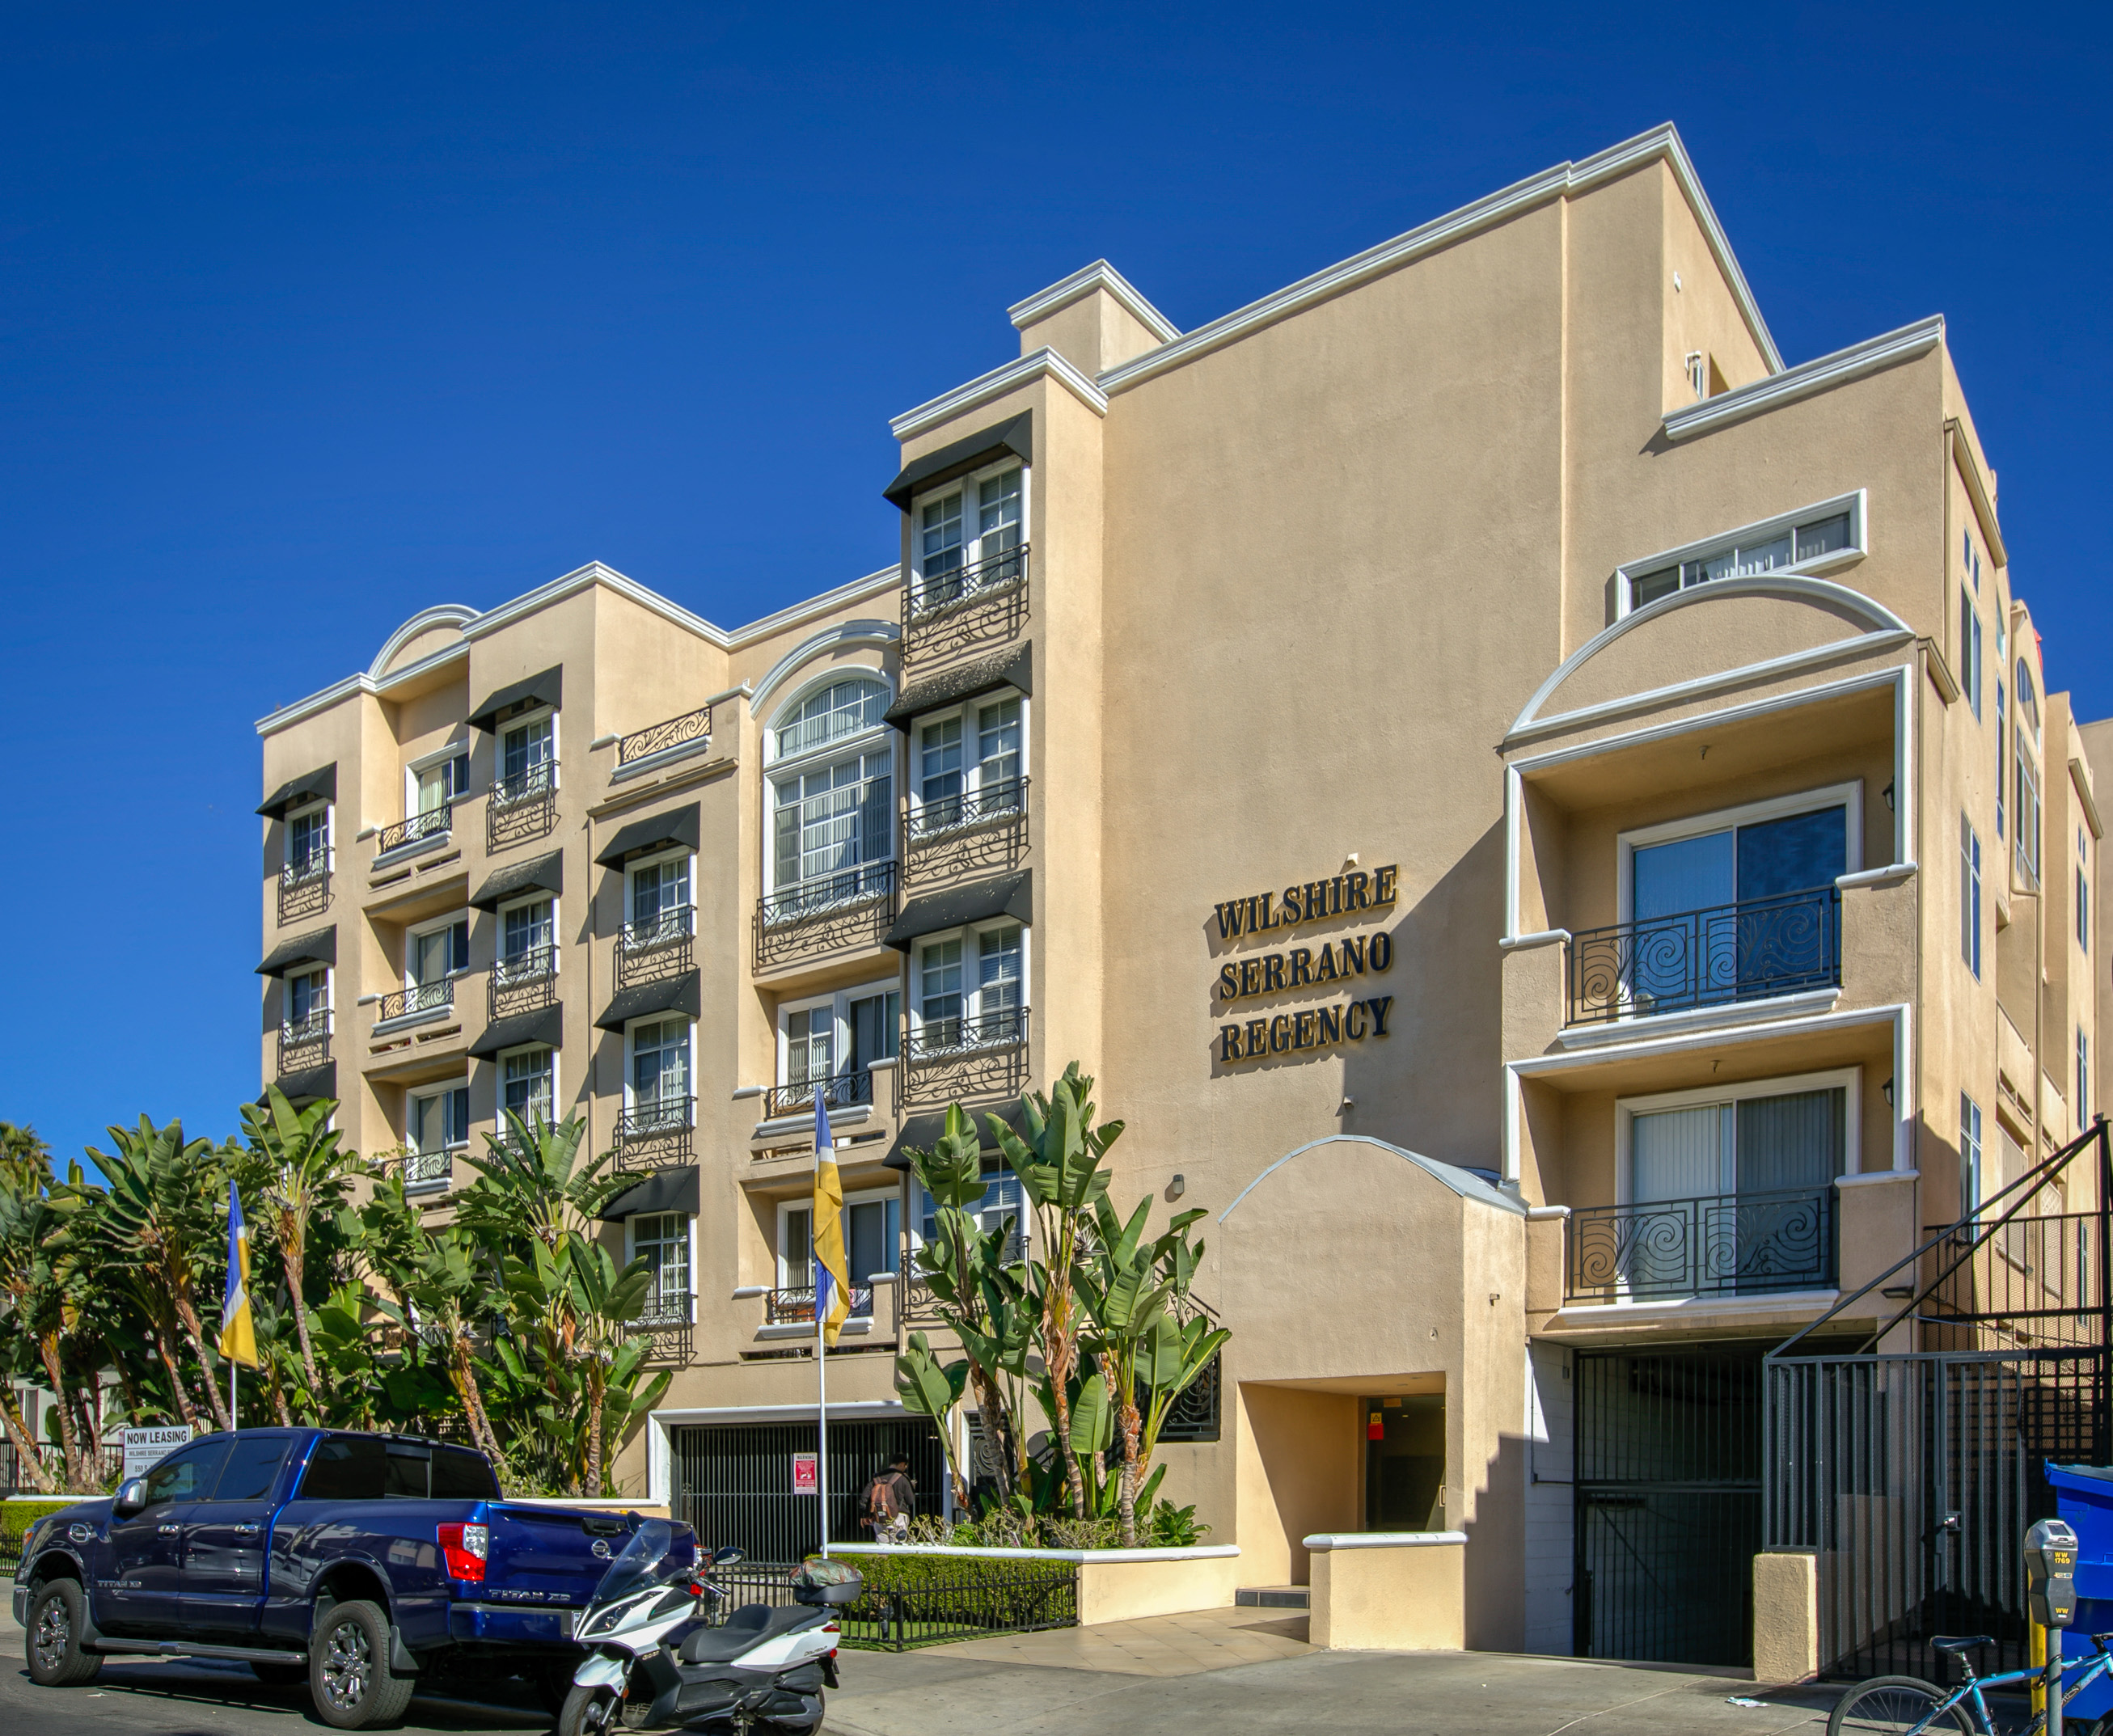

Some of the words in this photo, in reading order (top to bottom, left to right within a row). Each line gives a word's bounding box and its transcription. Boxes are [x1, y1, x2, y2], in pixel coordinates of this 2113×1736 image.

[1214, 864, 1400, 940] WILSHIRE
[1219, 931, 1393, 1002] SERRANO
[1219, 995, 1394, 1063] REGENCY
[127, 1432, 147, 1445] NOW
[150, 1430, 187, 1444] LEASING
[488, 1589, 544, 1600] TITAN
